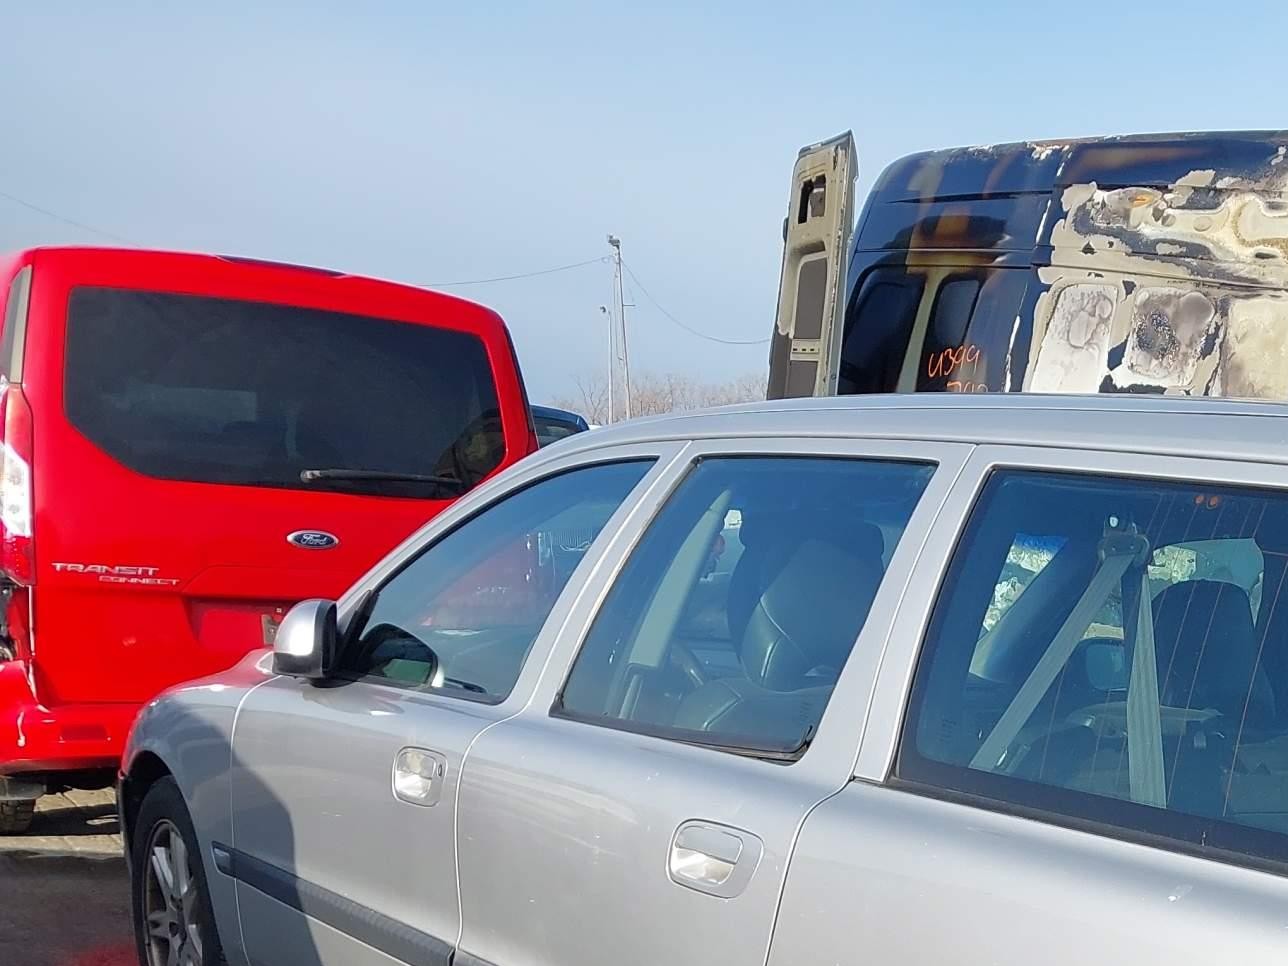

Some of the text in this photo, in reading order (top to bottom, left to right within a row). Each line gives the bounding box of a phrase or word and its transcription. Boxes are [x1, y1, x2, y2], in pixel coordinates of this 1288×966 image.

[301, 533, 328, 545] Ford
[52, 562, 160, 576] TRANSIT
[98, 575, 179, 586] CONNECT
